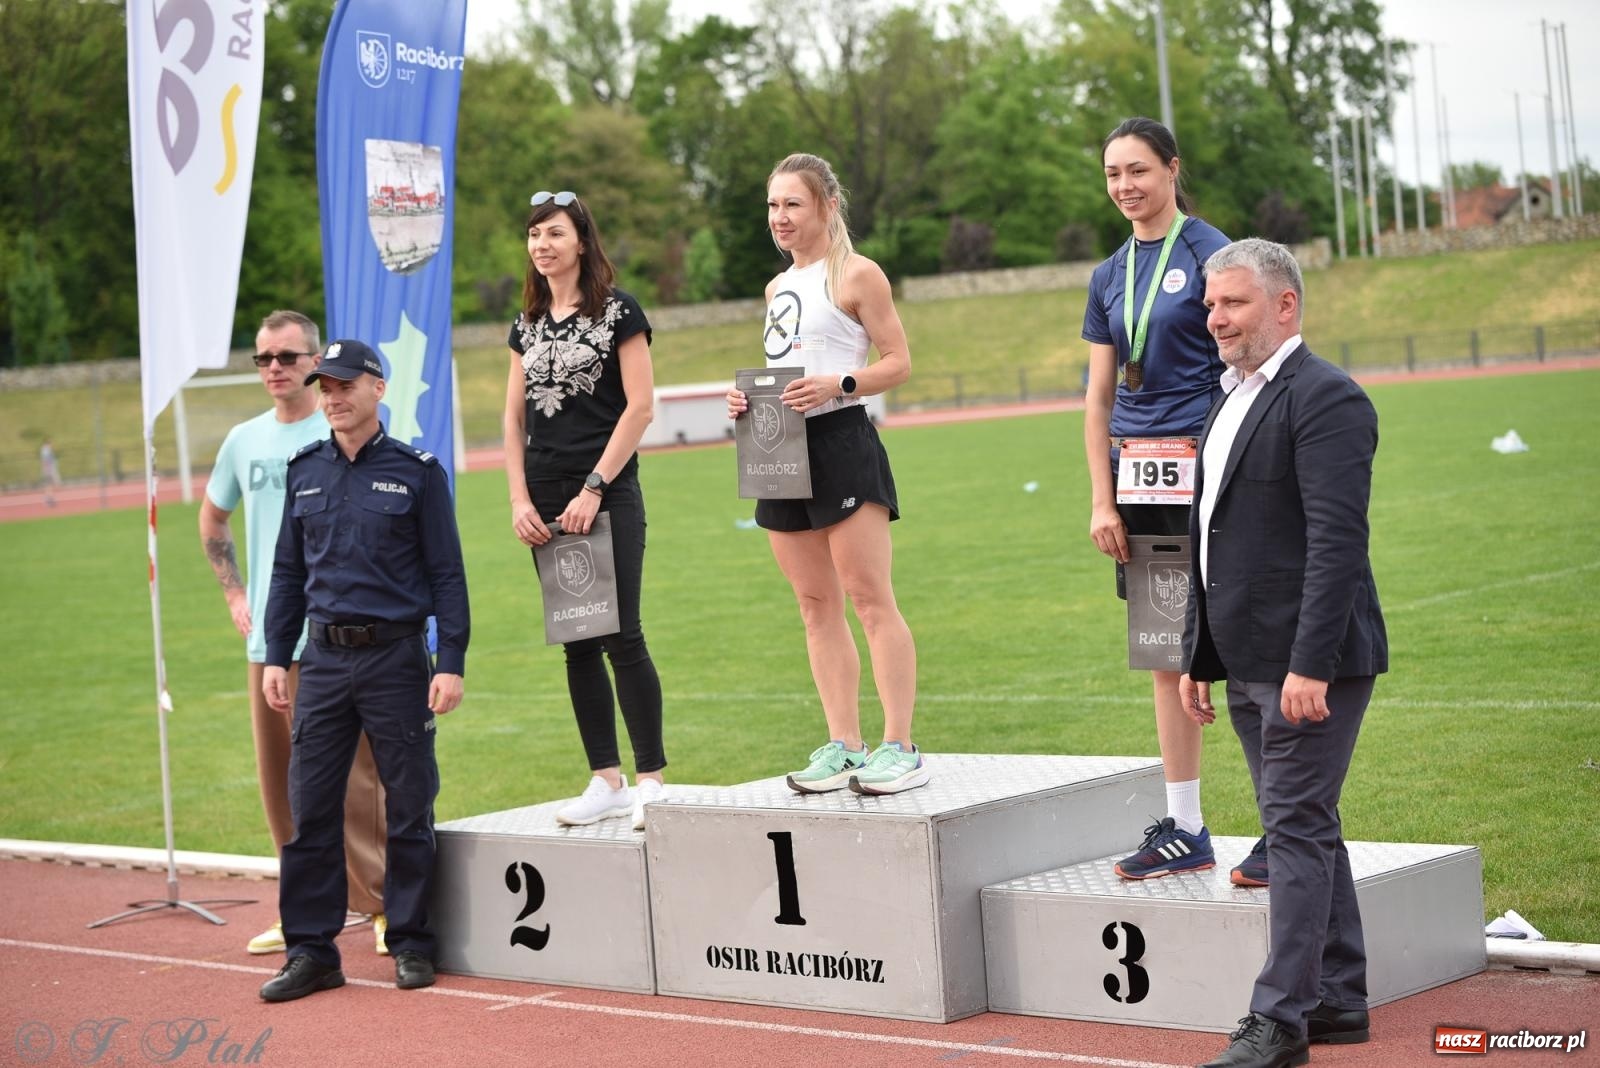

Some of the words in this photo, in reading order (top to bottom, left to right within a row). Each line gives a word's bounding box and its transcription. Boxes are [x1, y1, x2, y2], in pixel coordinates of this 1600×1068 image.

[746, 460, 798, 476] RACIBÓRZ
[1132, 461, 1180, 487] 195
[372, 481, 408, 495] POLICJA
[553, 601, 609, 622] RACIBÓRZ
[1139, 632, 1182, 645] RACIB
[767, 831, 807, 926] 1
[505, 861, 551, 951] 2
[706, 944, 760, 973] OSIR
[766, 950, 885, 983] RACIBÓRZ
[1102, 921, 1150, 1004] 3
